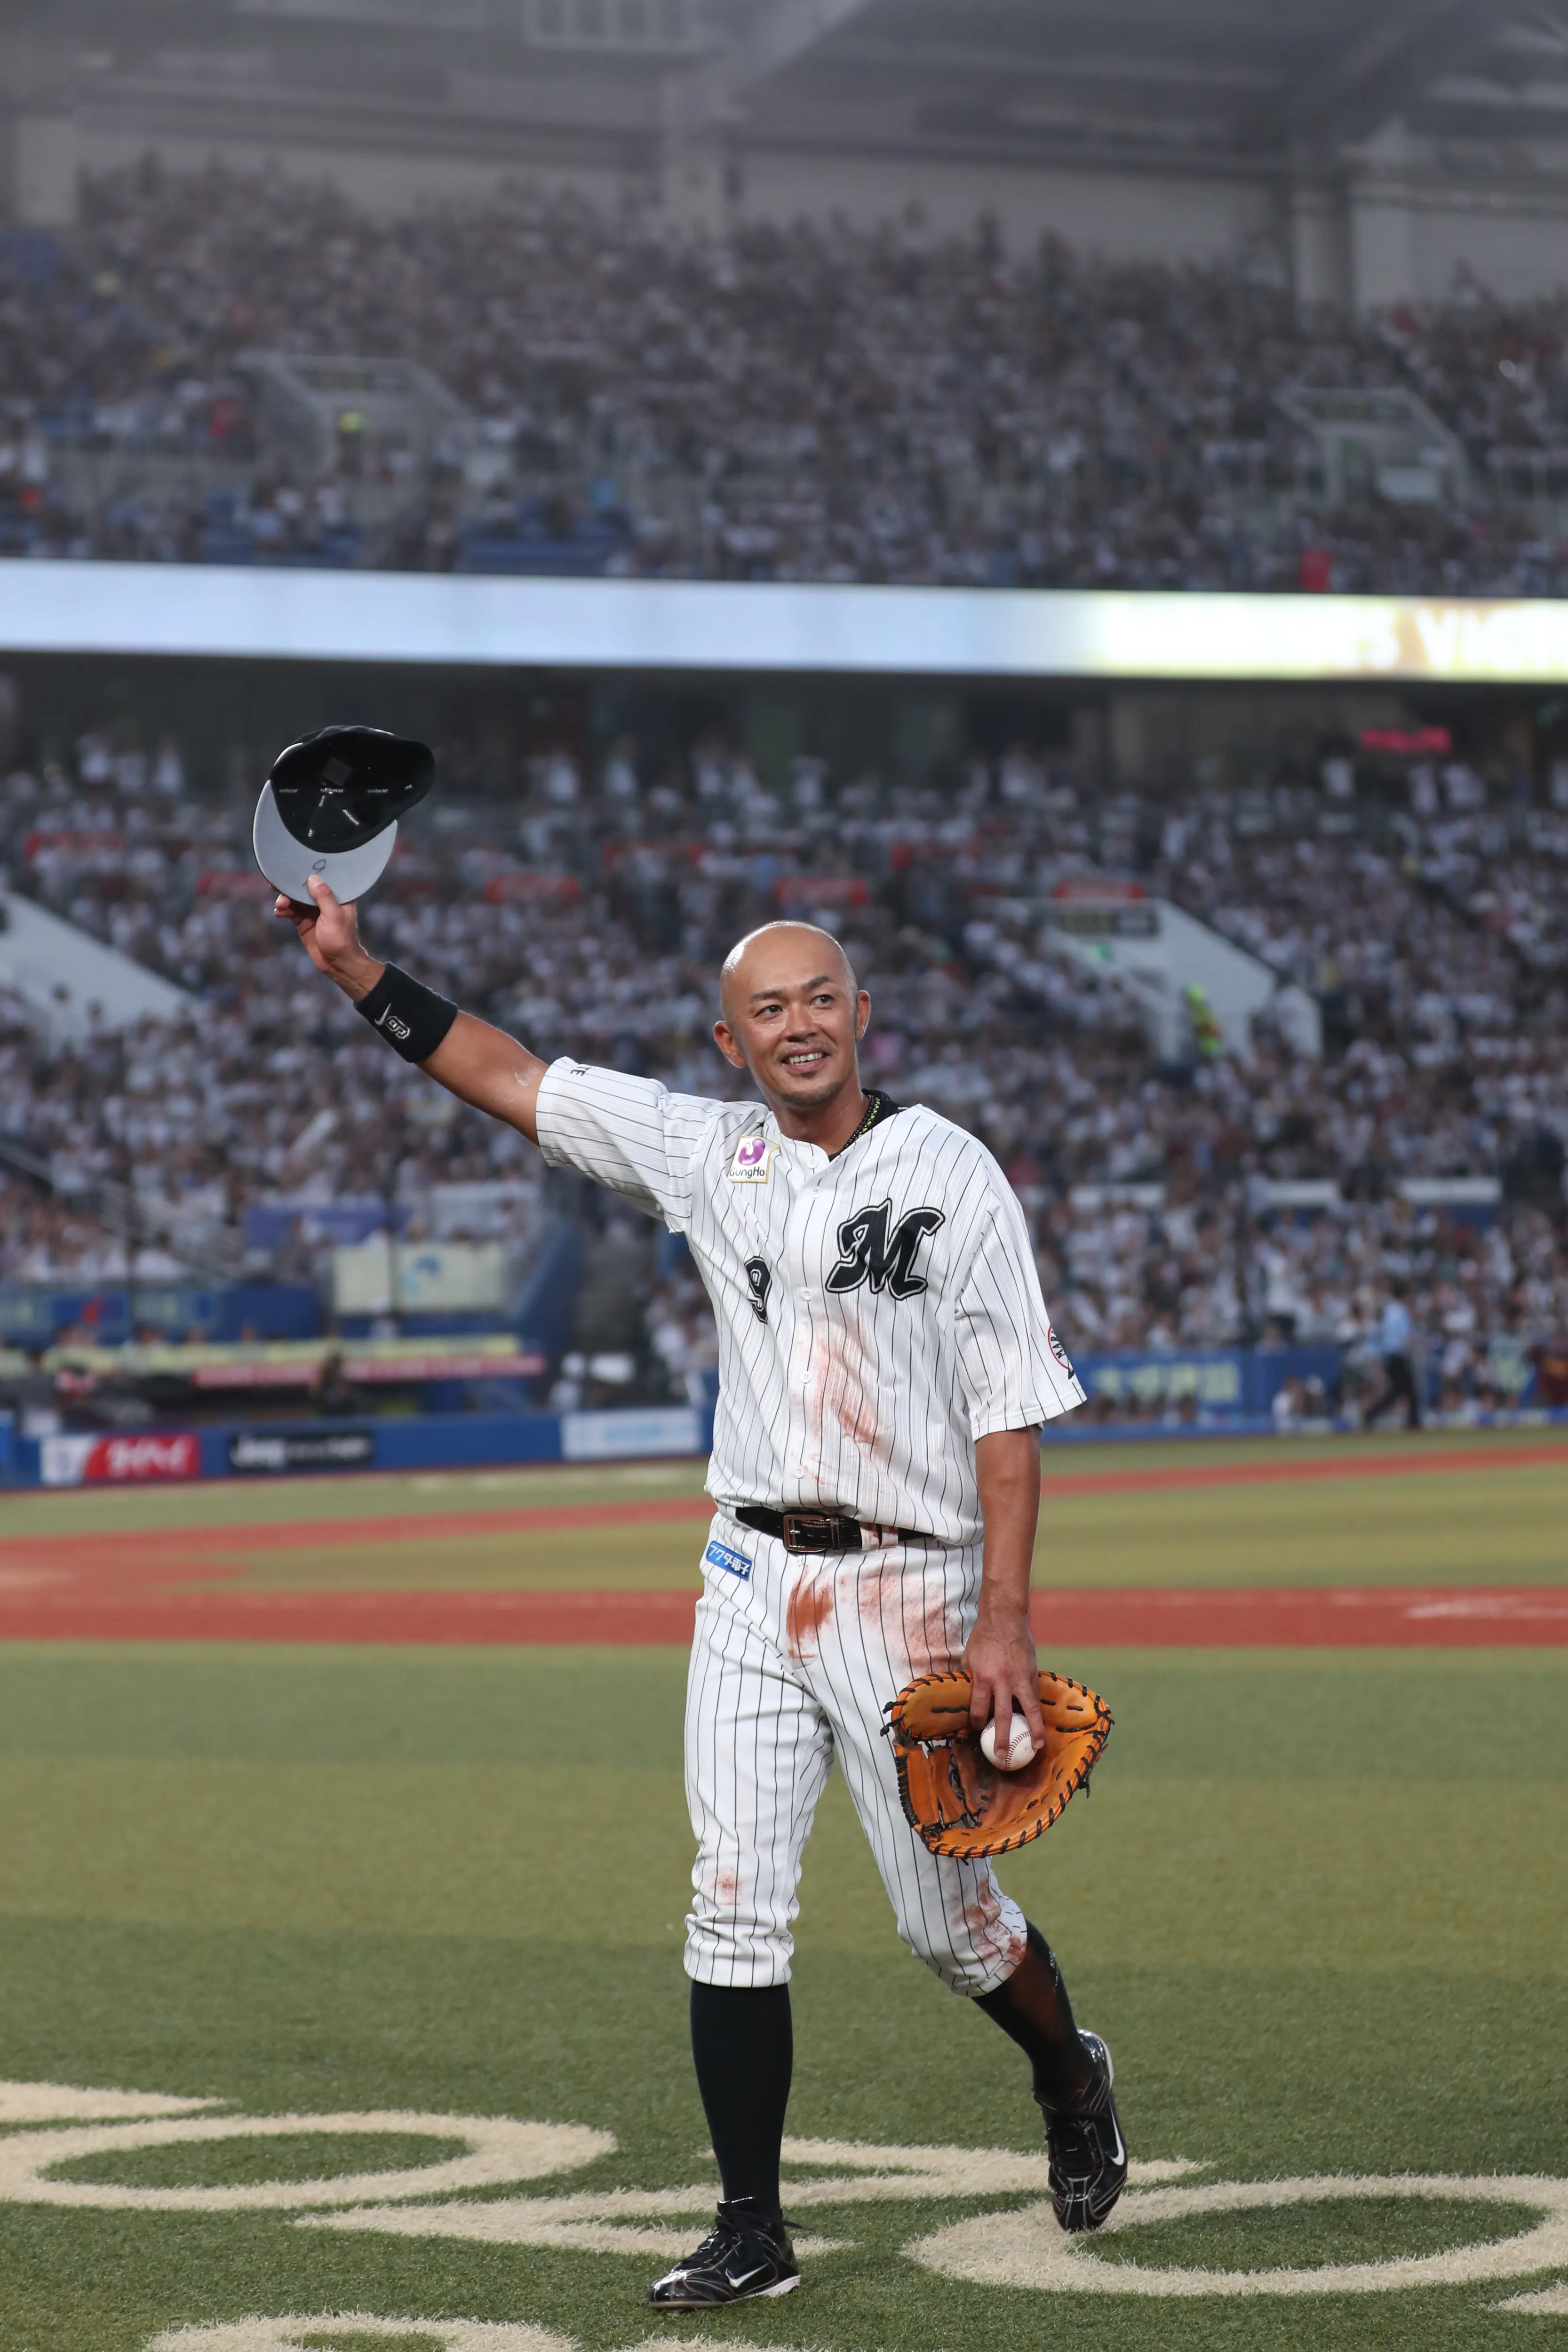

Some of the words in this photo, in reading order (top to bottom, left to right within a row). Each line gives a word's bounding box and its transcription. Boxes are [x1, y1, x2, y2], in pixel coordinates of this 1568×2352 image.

[729, 1166, 765, 1179] GungHo
[825, 1197, 946, 1301] M
[1051, 1331, 1066, 1359] MAR
